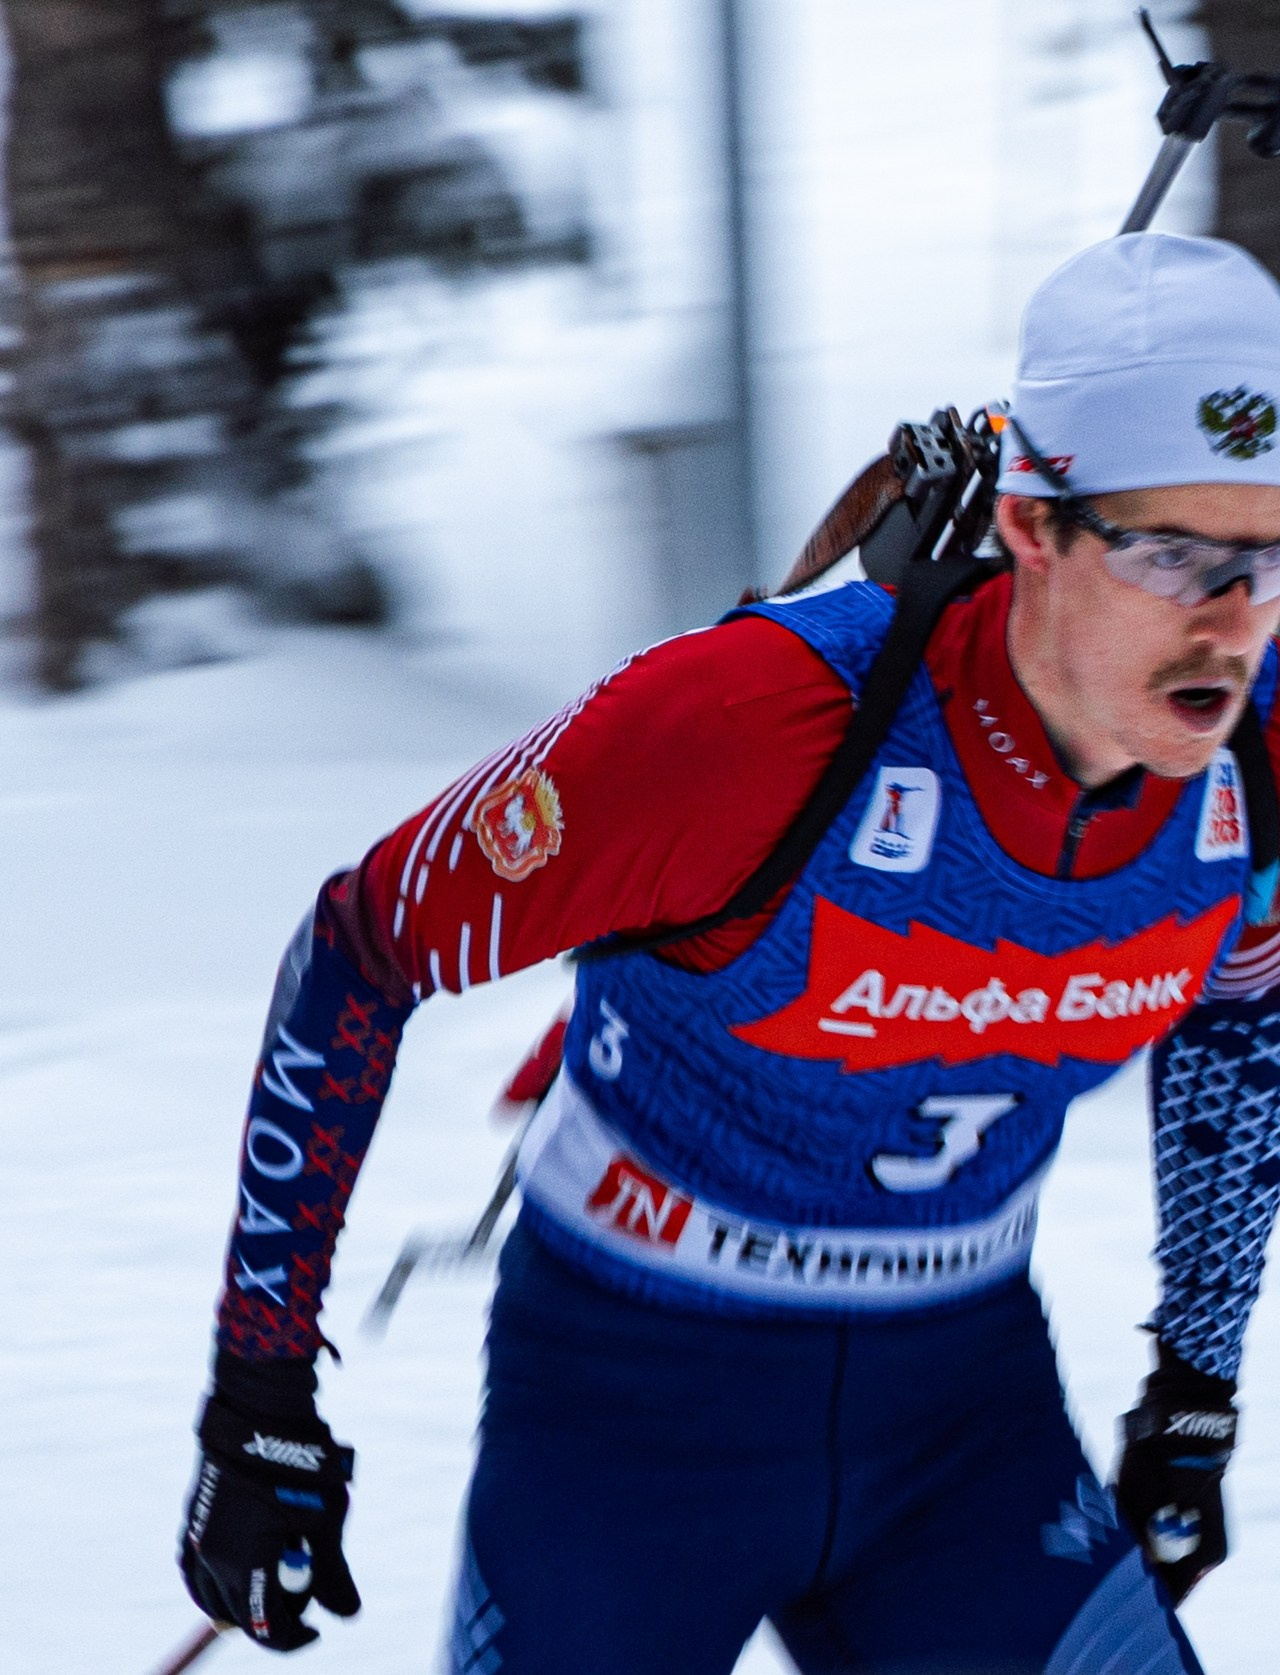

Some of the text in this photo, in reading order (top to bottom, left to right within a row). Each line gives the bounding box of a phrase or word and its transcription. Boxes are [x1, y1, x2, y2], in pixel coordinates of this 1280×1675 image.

[588, 996, 631, 1080] 3
[819, 966, 1194, 1036] Альфа Банк
[233, 1022, 327, 1308] MOAX
[871, 1093, 1022, 1193] 3
